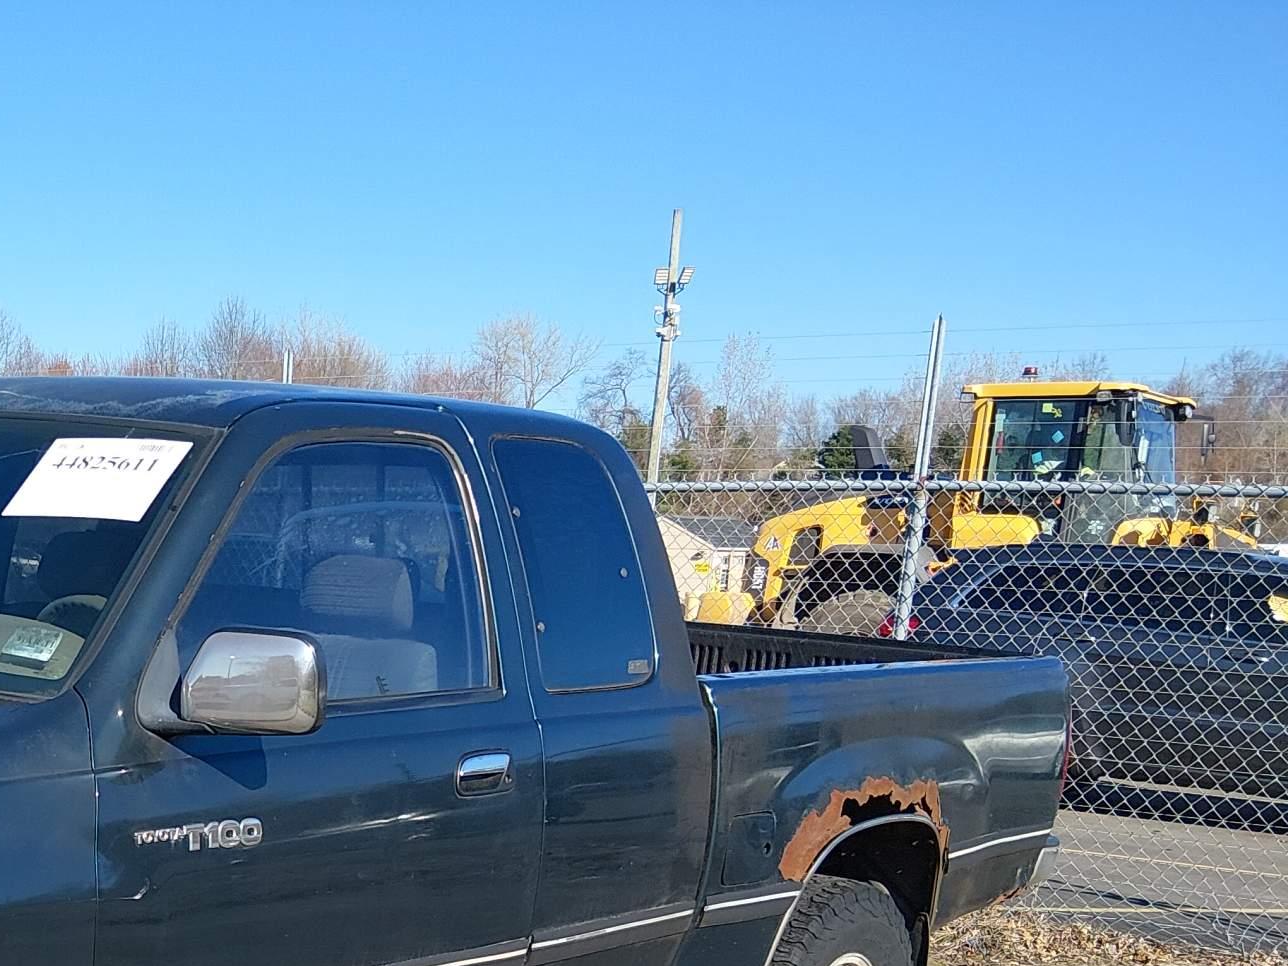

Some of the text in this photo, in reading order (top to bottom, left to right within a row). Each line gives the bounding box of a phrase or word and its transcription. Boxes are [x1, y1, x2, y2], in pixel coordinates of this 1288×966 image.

[52, 455, 160, 472] 44825611
[133, 816, 263, 852] TOYOTA T100
